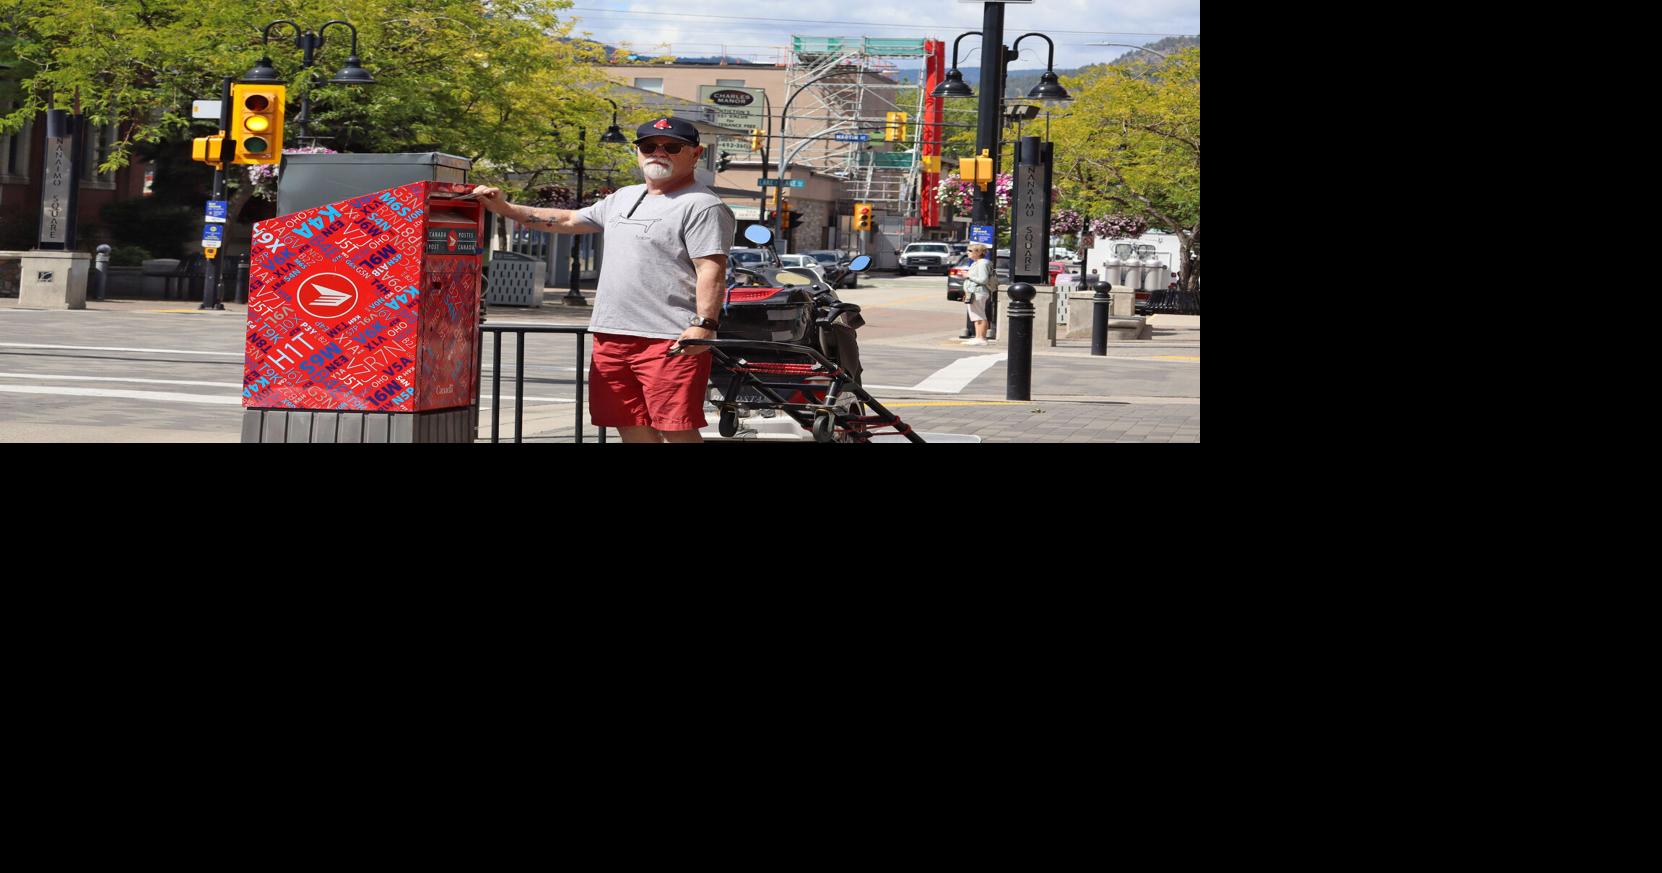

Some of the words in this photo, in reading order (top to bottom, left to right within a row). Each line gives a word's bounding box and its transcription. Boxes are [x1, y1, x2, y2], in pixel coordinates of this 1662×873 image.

[52, 138, 63, 186] NANAIMO
[379, 192, 411, 216] M6S
[1026, 167, 1035, 217] NANAIMO
[50, 194, 60, 238] SQUARE
[291, 204, 342, 238] K4A
[321, 219, 345, 237] E3N
[367, 212, 391, 231] S4N
[334, 238, 360, 253] J5T
[343, 222, 373, 247] V7J
[358, 243, 397, 269] M9L
[1025, 227, 1033, 271] SQUARE
[371, 263, 389, 277] A1B
[248, 300, 273, 317] J5T
[256, 284, 286, 309] V7J
[384, 285, 420, 310] K4A
[300, 321, 318, 335] P3Y
[267, 331, 314, 371] H1T
[298, 341, 343, 374] M6S
[325, 355, 349, 373] E3N
[346, 356, 377, 383] V7J
[381, 357, 413, 376] V5A
[338, 373, 364, 390] J5T
